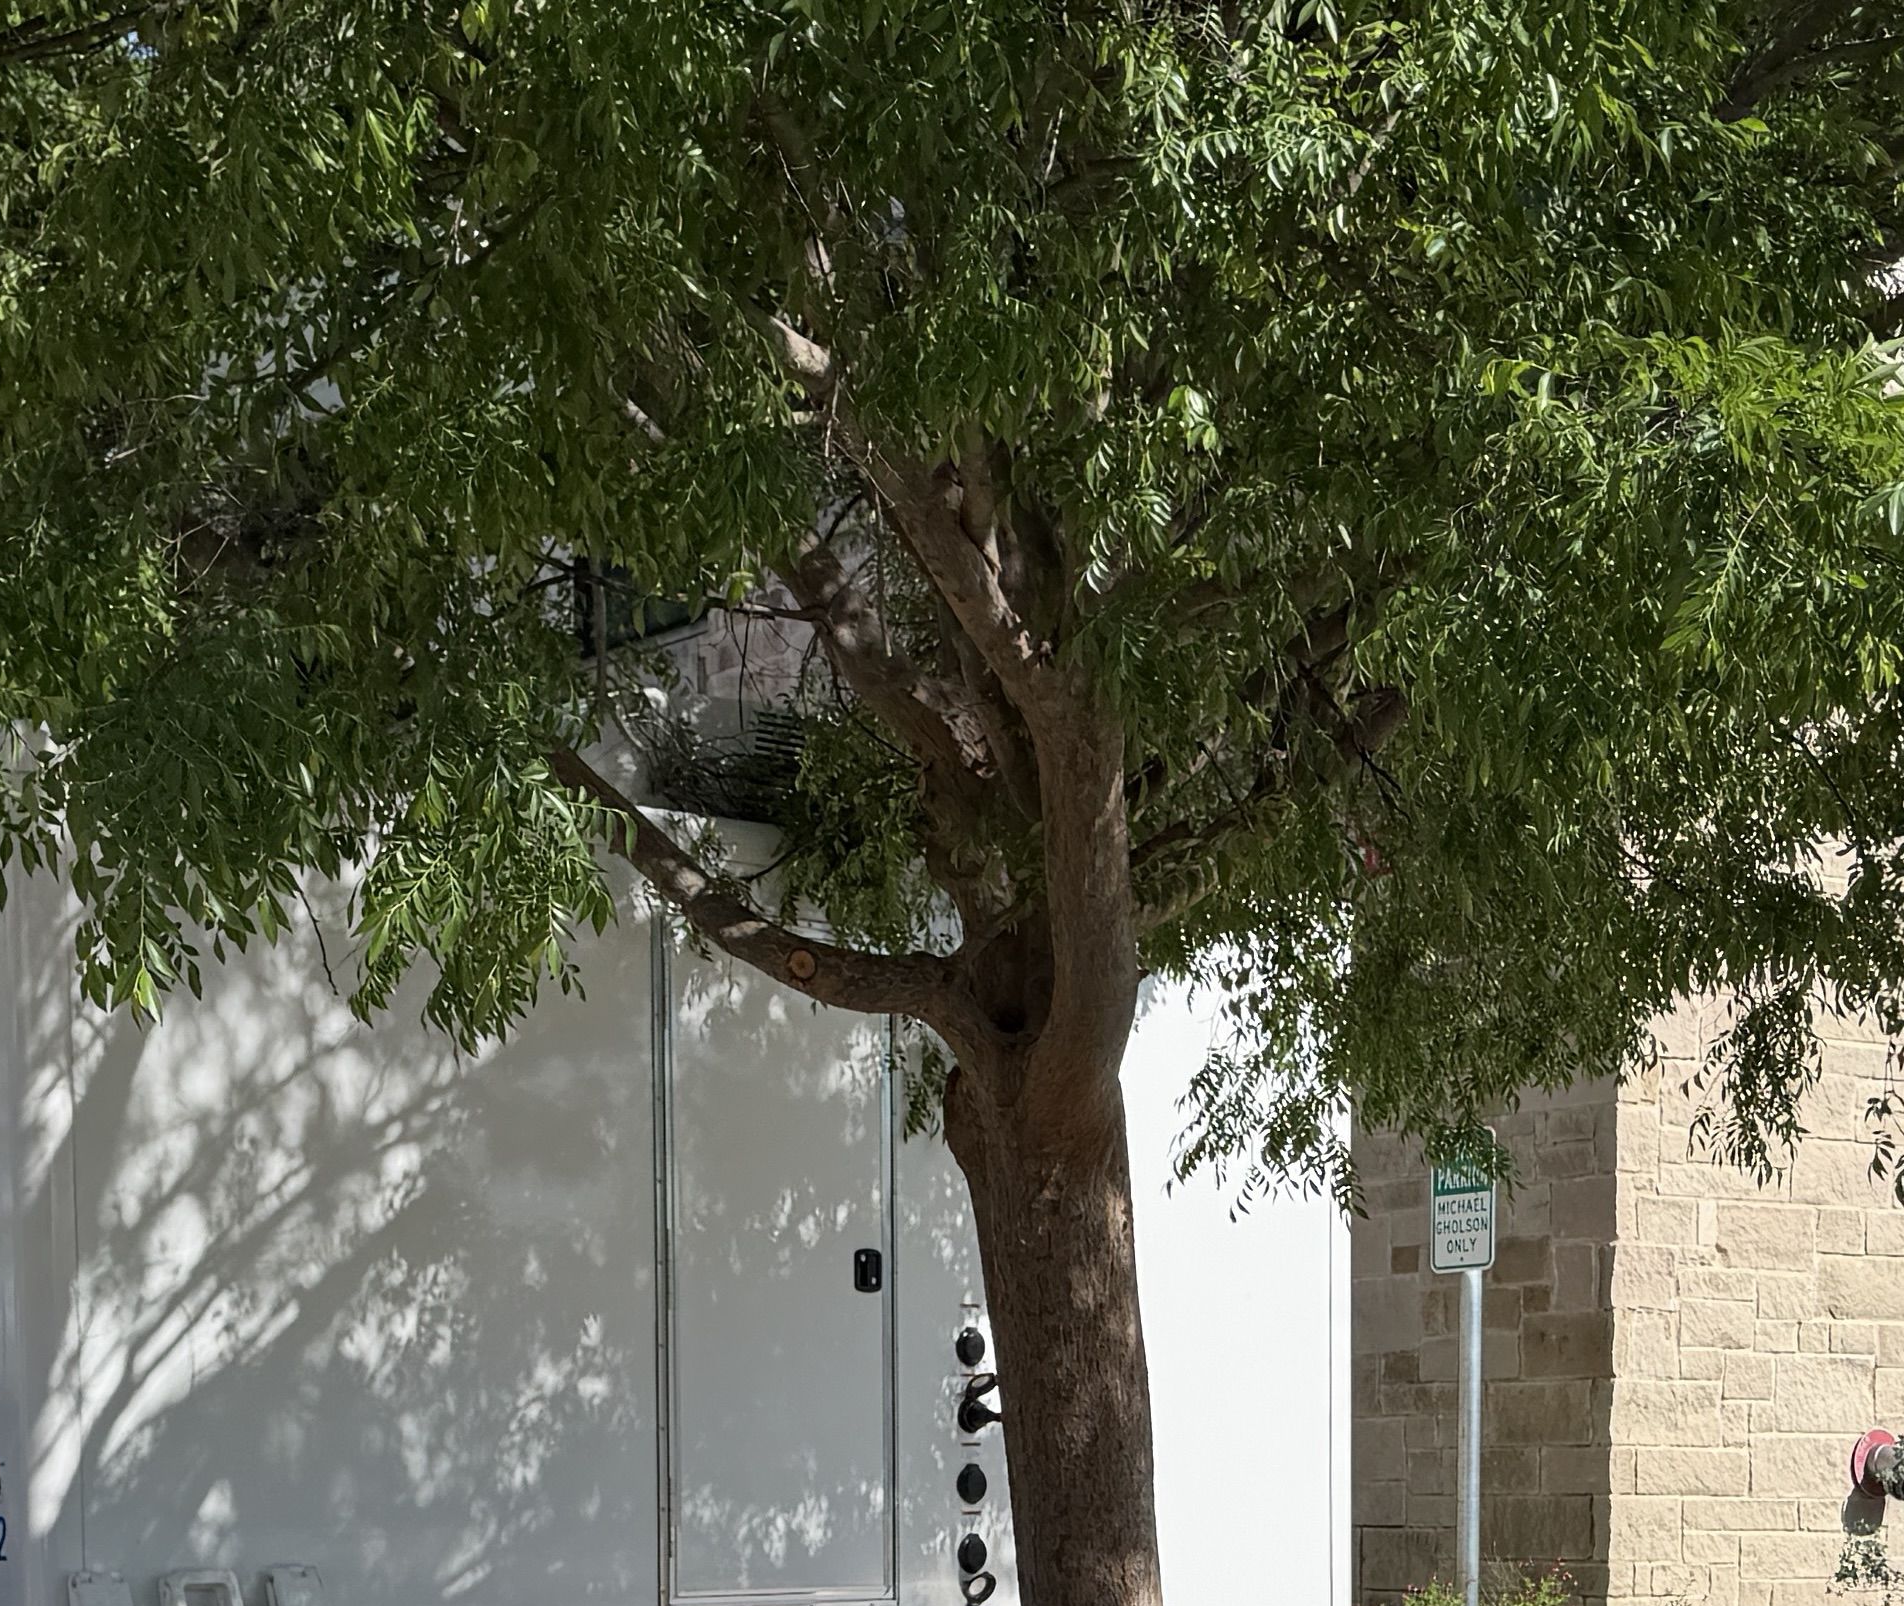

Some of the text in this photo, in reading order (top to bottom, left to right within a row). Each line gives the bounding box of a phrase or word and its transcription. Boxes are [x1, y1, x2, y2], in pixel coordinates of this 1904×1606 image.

[1438, 1197, 1487, 1215] MICHAEL
[1436, 1217, 1488, 1235] GHOLSON
[1446, 1238, 1477, 1254] ONLY
